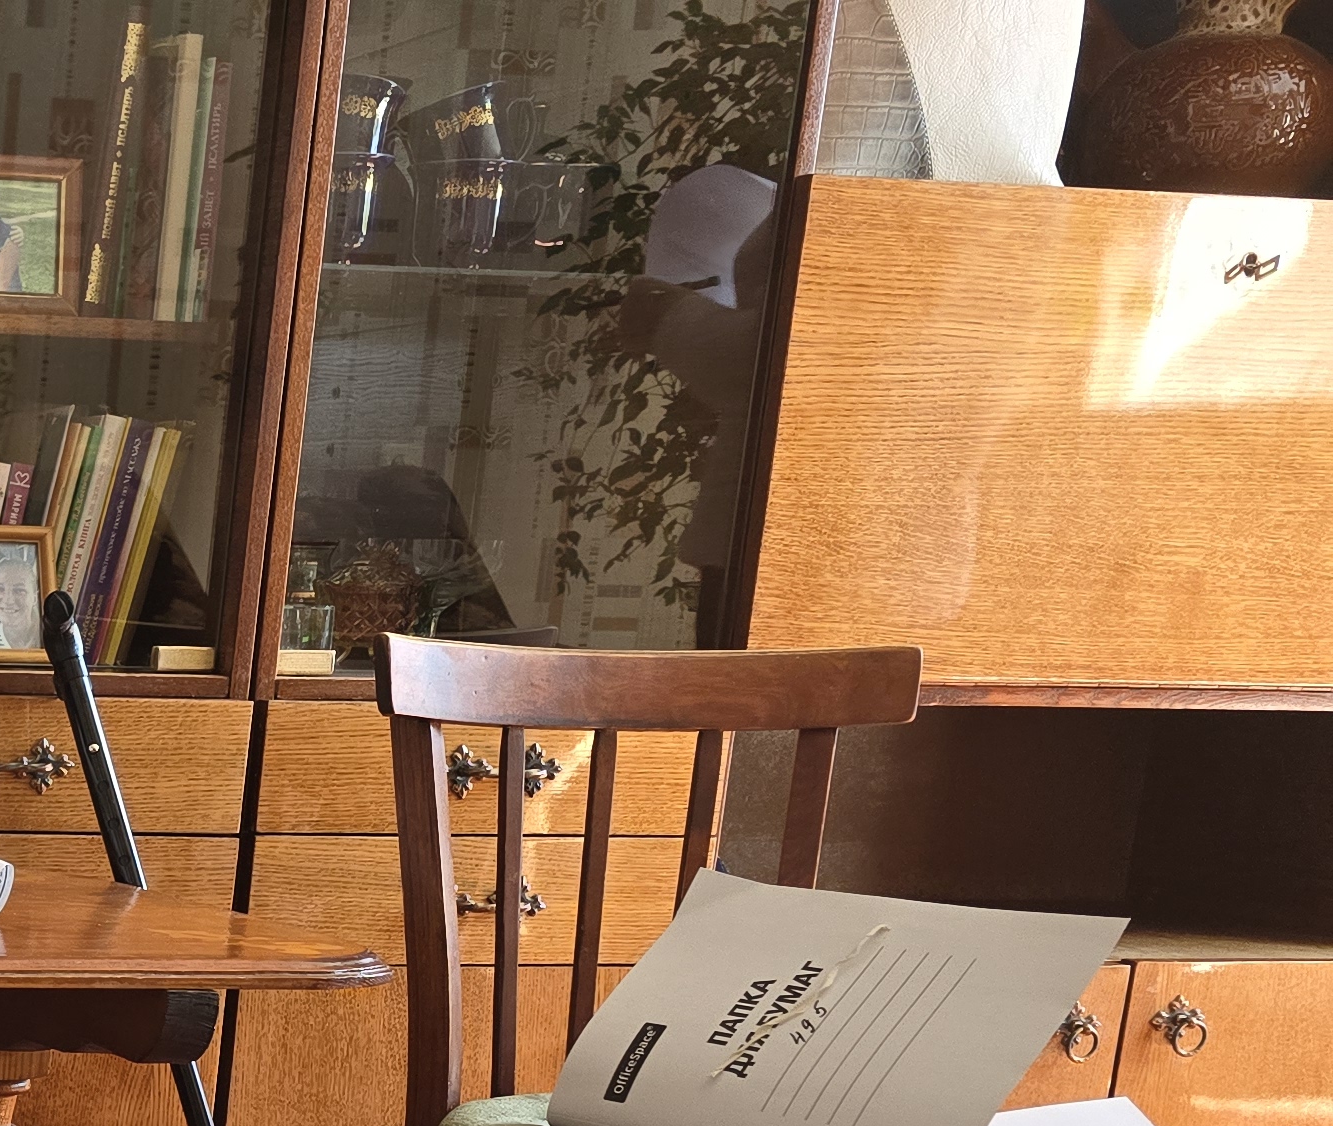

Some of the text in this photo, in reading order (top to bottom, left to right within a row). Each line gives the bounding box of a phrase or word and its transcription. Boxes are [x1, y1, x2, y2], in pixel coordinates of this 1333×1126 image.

[101, 85, 134, 240] НОВЫЙ ЗАВЕТ ПСАЛТИРЬ
[207, 102, 223, 170] ПСАЛТИРЬ
[201, 190, 216, 228] ЗАВЕТ
[77, 518, 92, 550] КНИГА
[707, 979, 777, 1046] ПАПКА
[790, 999, 828, 1046] 495
